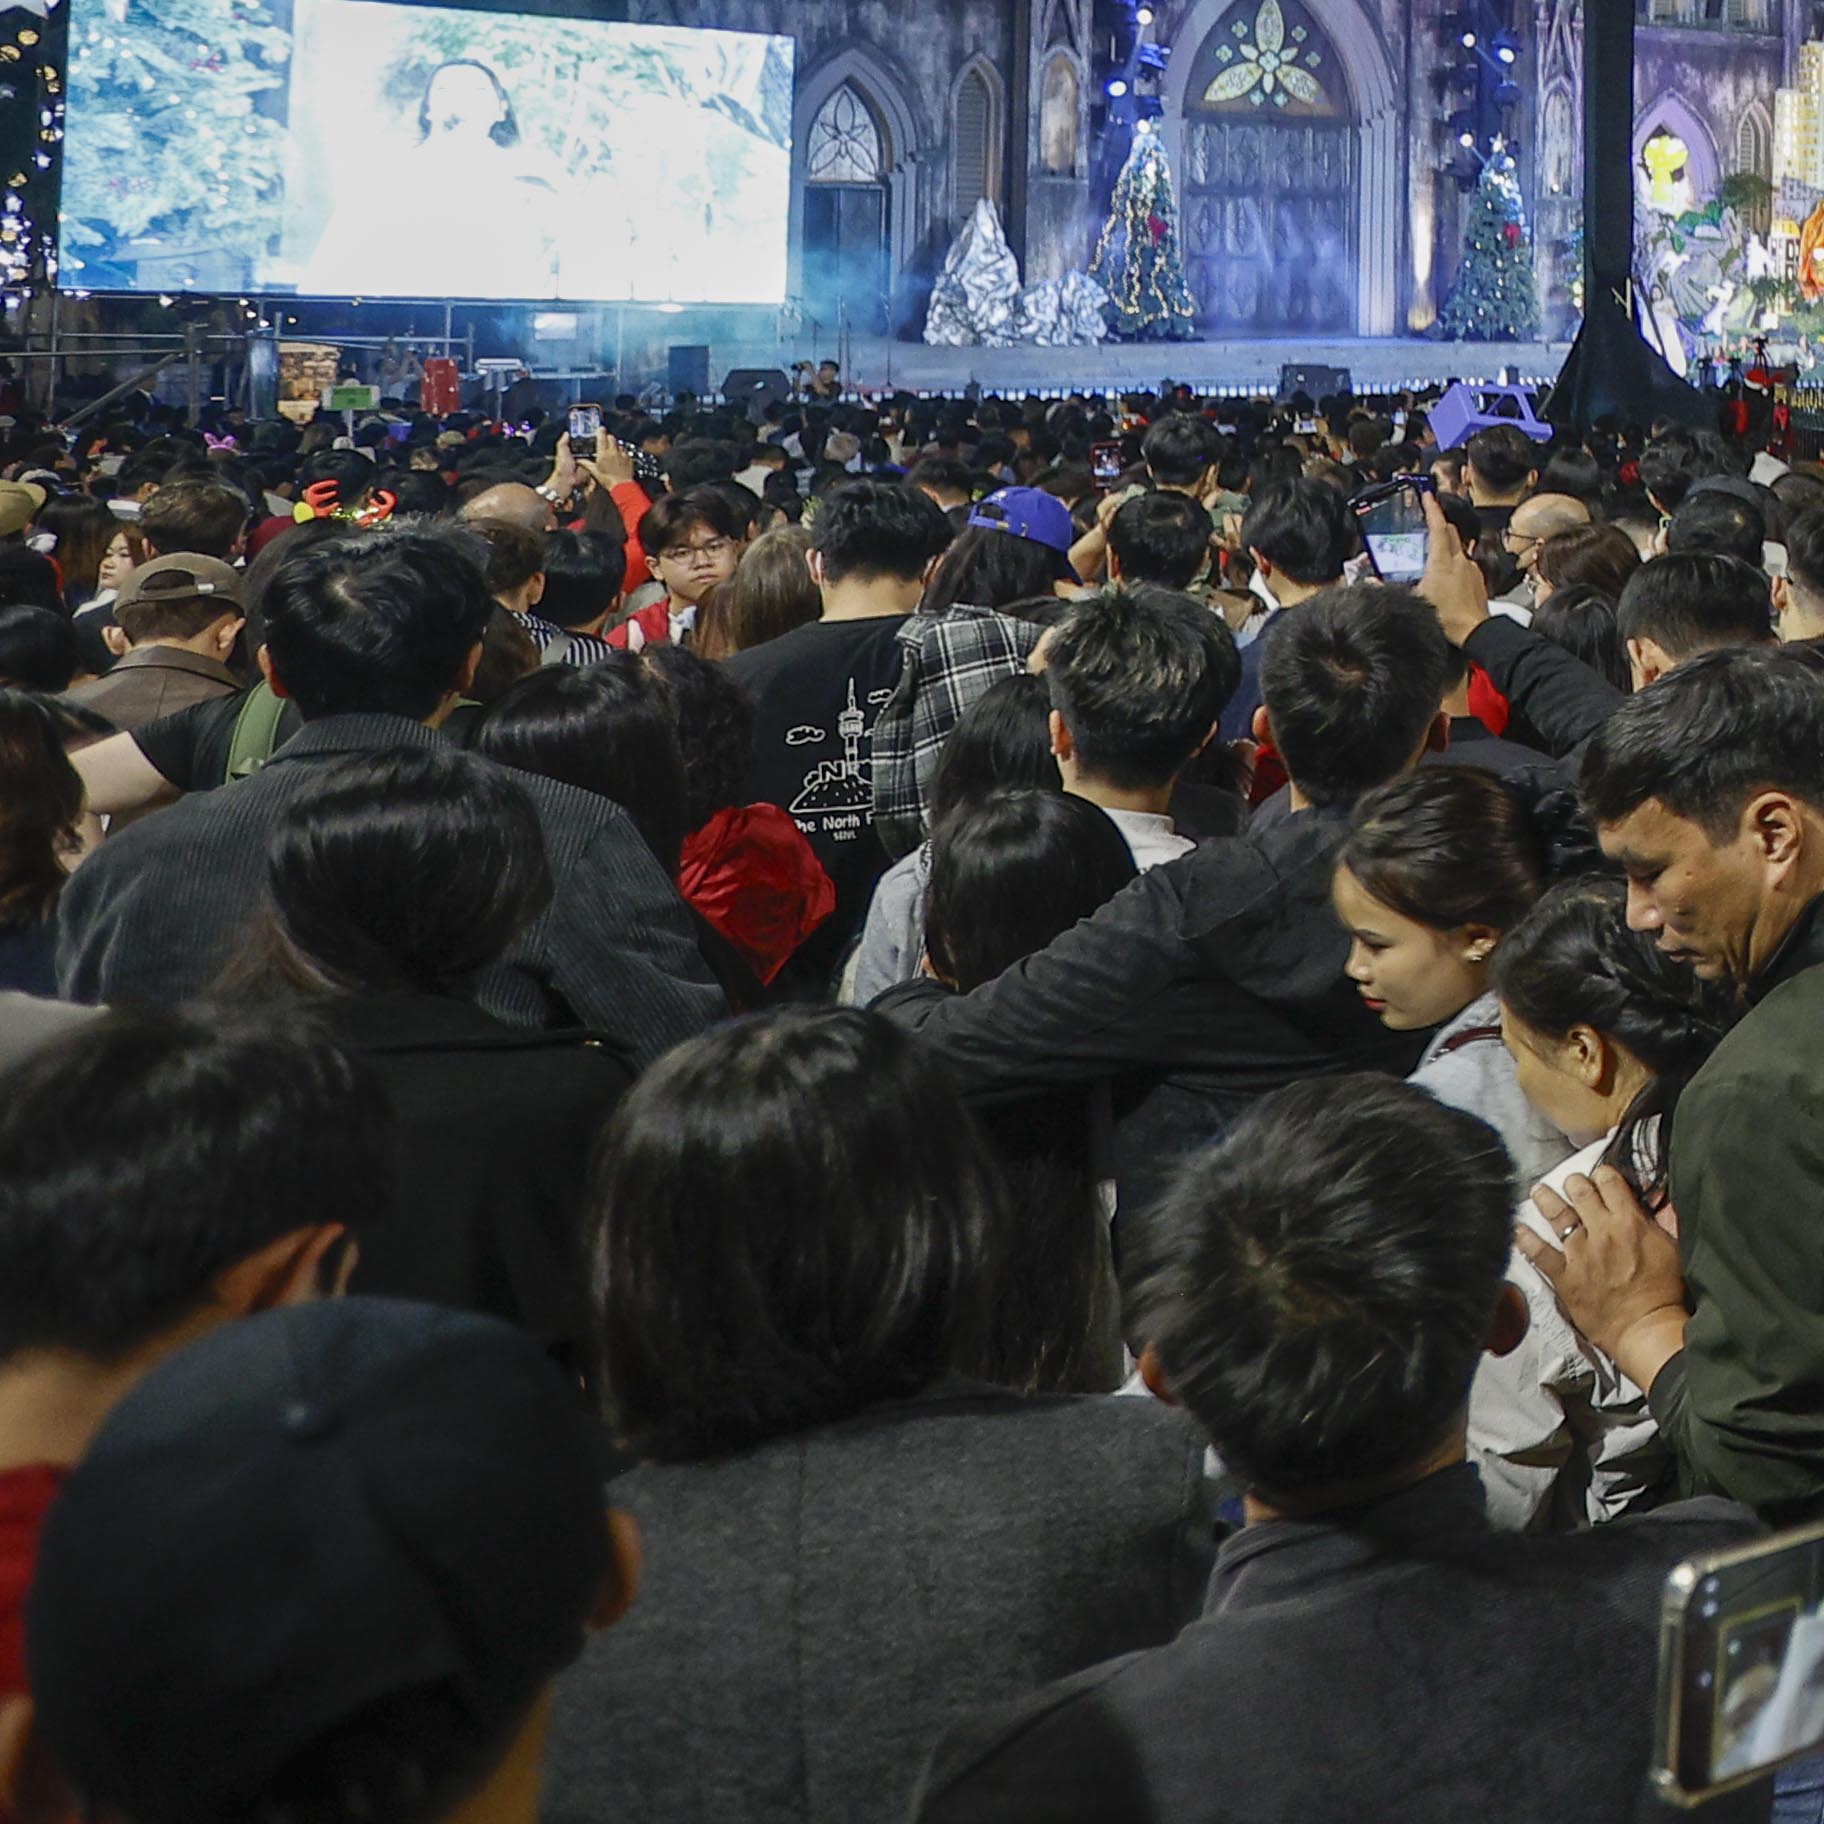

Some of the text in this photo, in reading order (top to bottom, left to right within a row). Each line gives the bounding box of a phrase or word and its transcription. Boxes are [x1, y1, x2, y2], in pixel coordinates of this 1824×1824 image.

[793, 811, 876, 834] he North F
